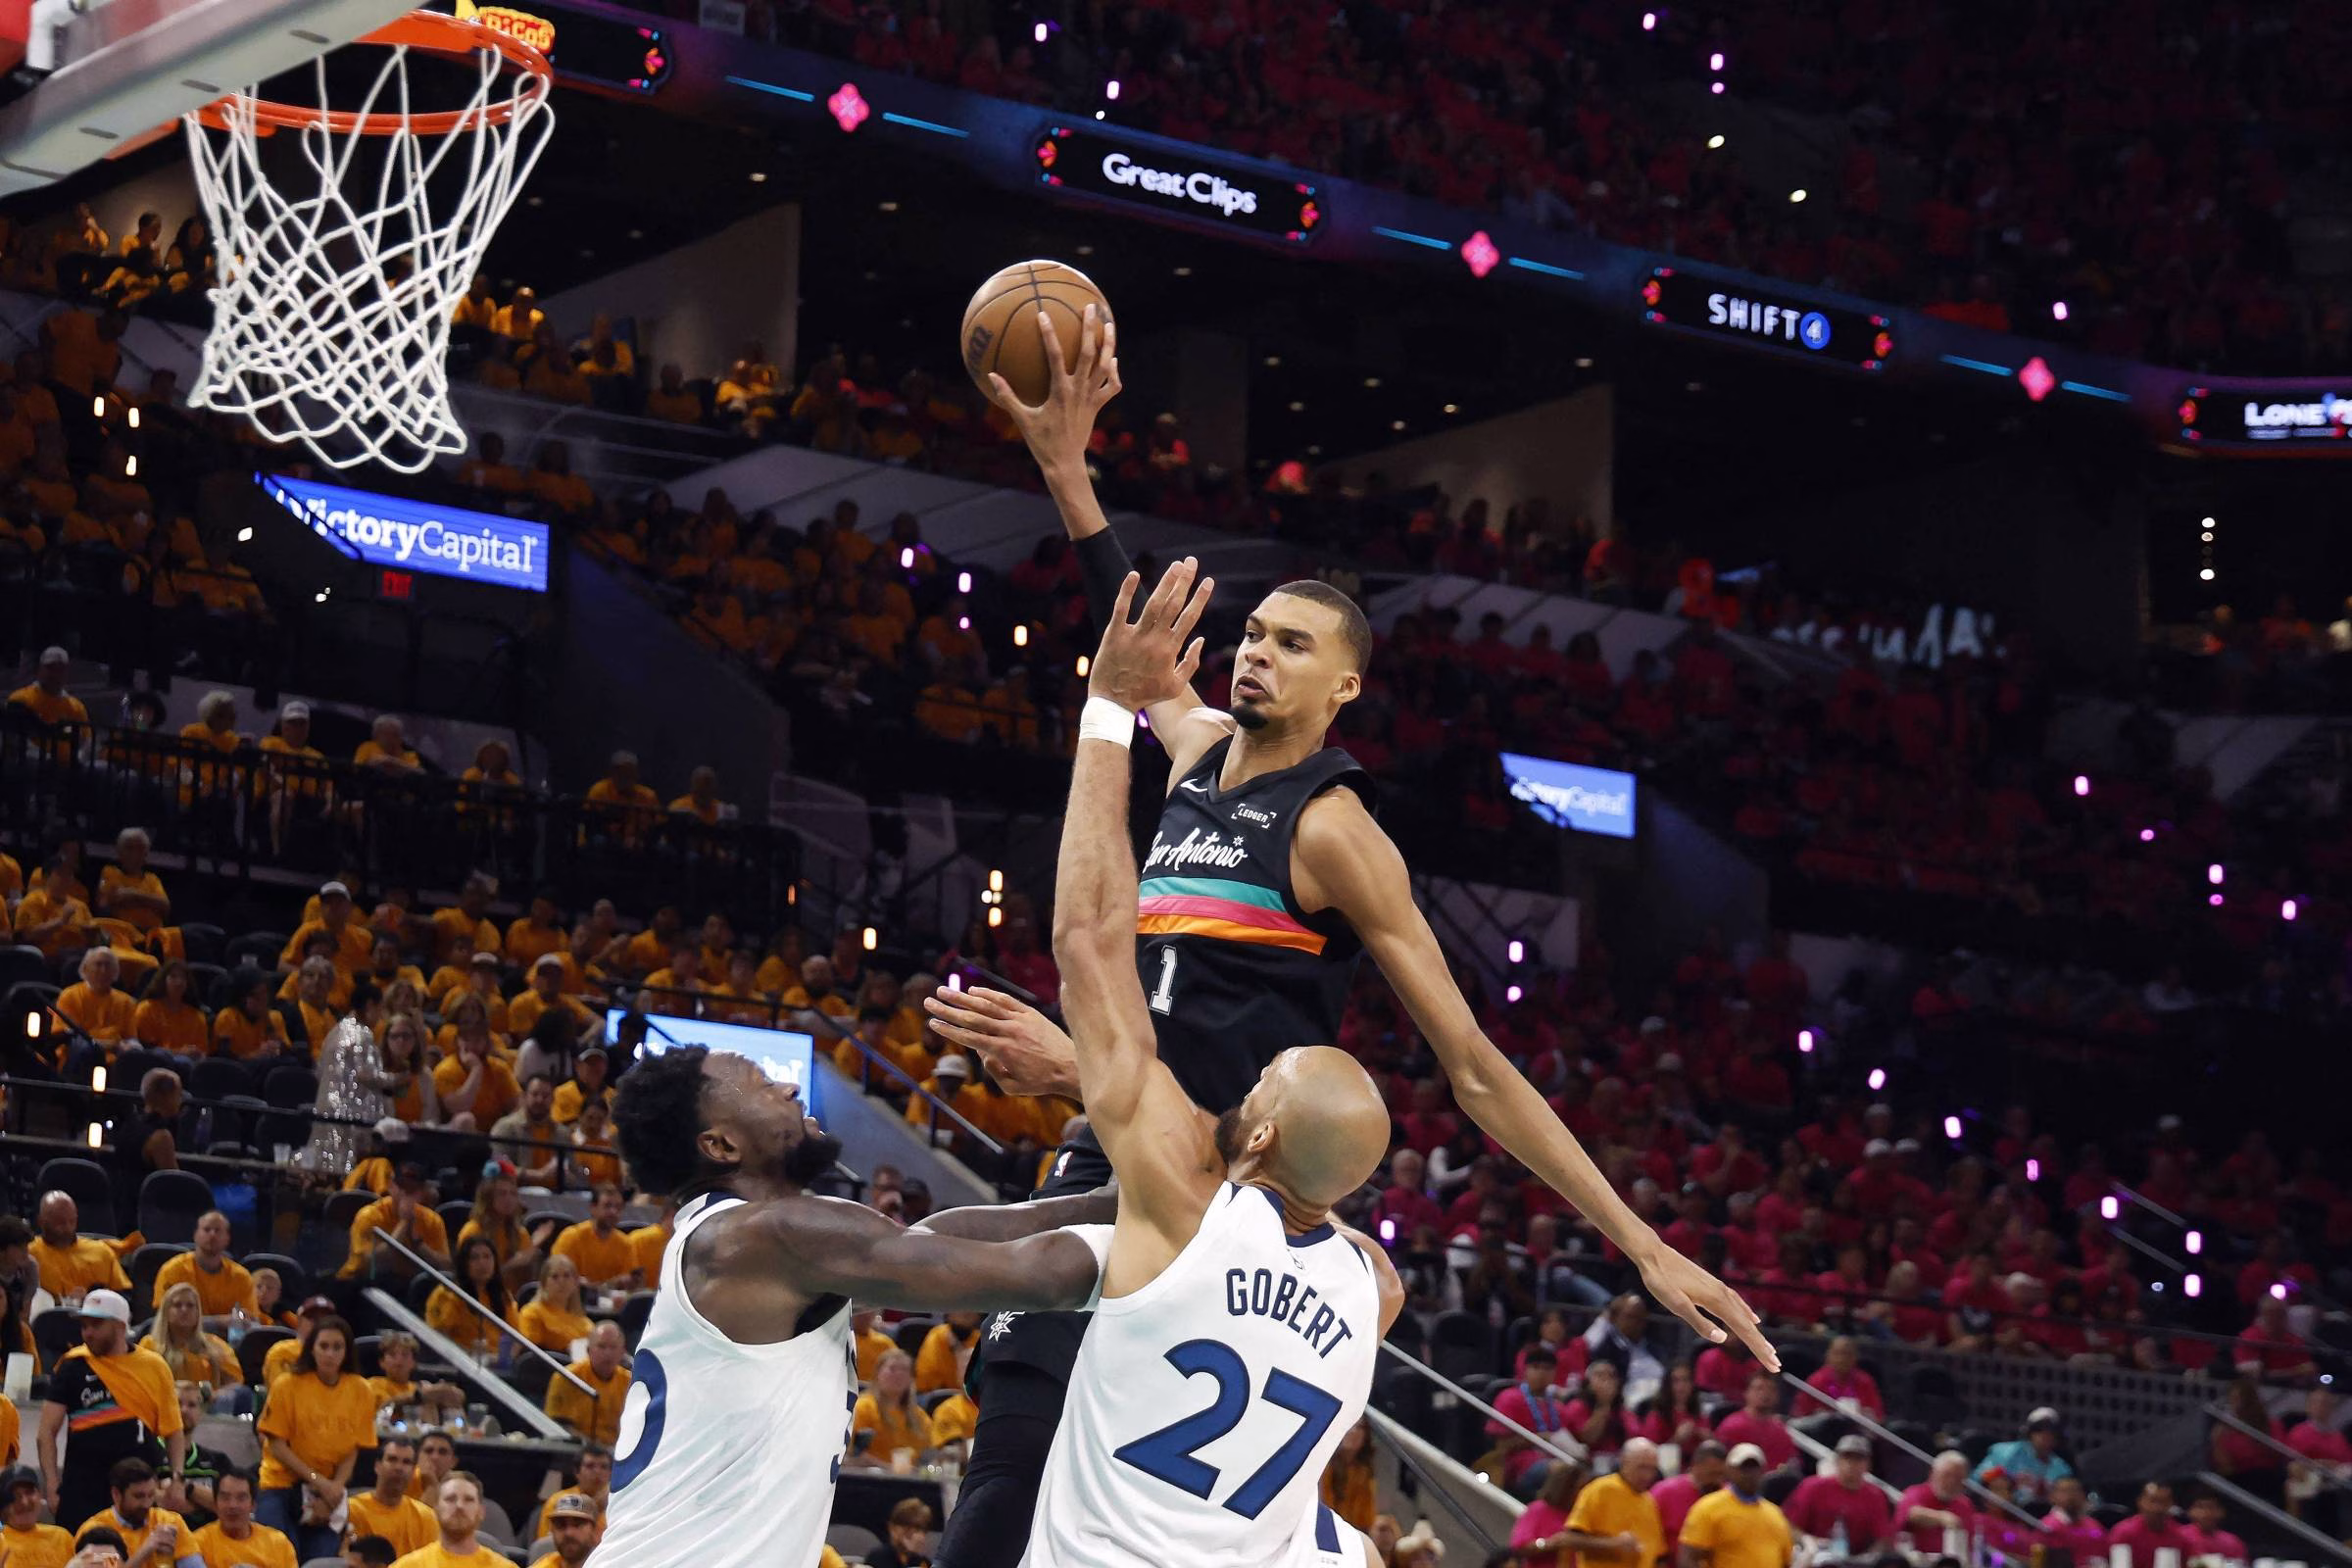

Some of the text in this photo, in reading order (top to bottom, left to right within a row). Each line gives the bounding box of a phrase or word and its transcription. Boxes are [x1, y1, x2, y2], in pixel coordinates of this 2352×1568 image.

[1102, 153, 1257, 217] Great Clips
[1164, 827, 1249, 871] Antonio
[1238, 808, 1269, 823] LEDGER
[1148, 944, 1178, 1016] 1
[1226, 1267, 1353, 1359] GOBERT
[1112, 1338, 1344, 1521] 27
